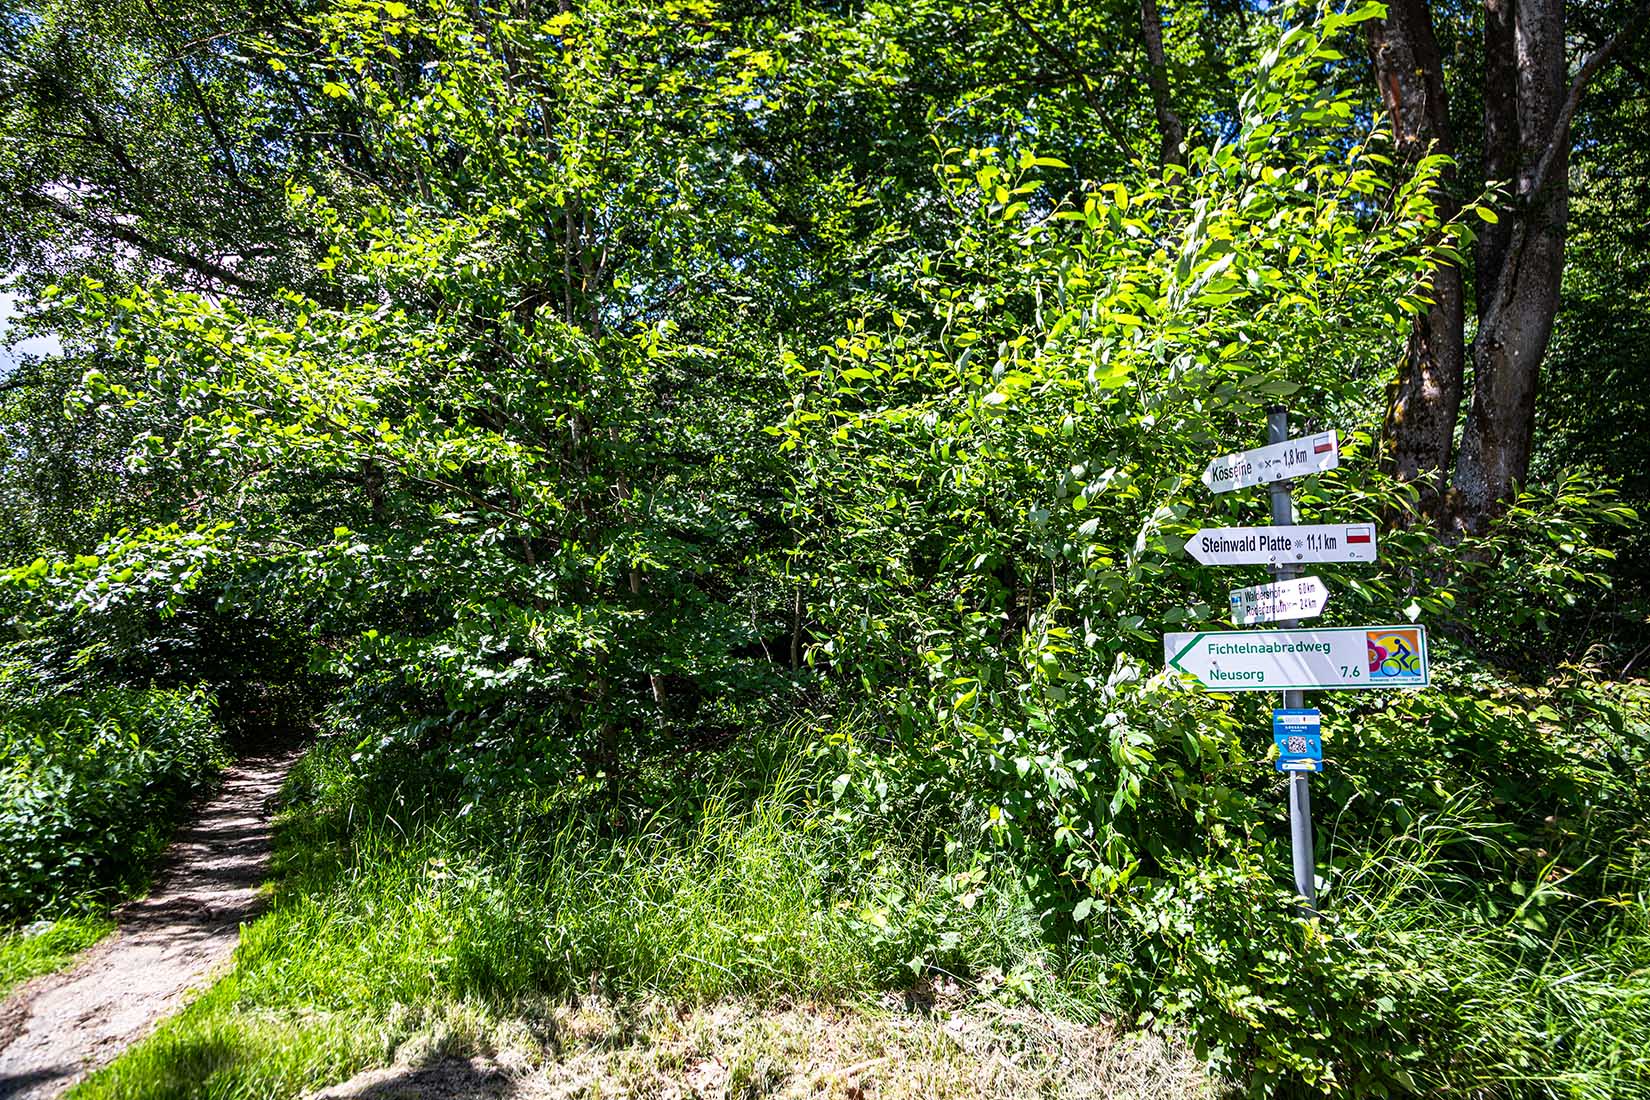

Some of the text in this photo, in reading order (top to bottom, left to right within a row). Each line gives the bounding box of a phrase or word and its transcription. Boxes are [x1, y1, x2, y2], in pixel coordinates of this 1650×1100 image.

[1212, 448, 1308, 482] Kösseine 1,8 km
[1201, 534, 1337, 553] Steinwald Platte 11,1 km
[1208, 641, 1331, 655] Fichtelnaabradweg
[1209, 669, 1264, 682] Neusorg
